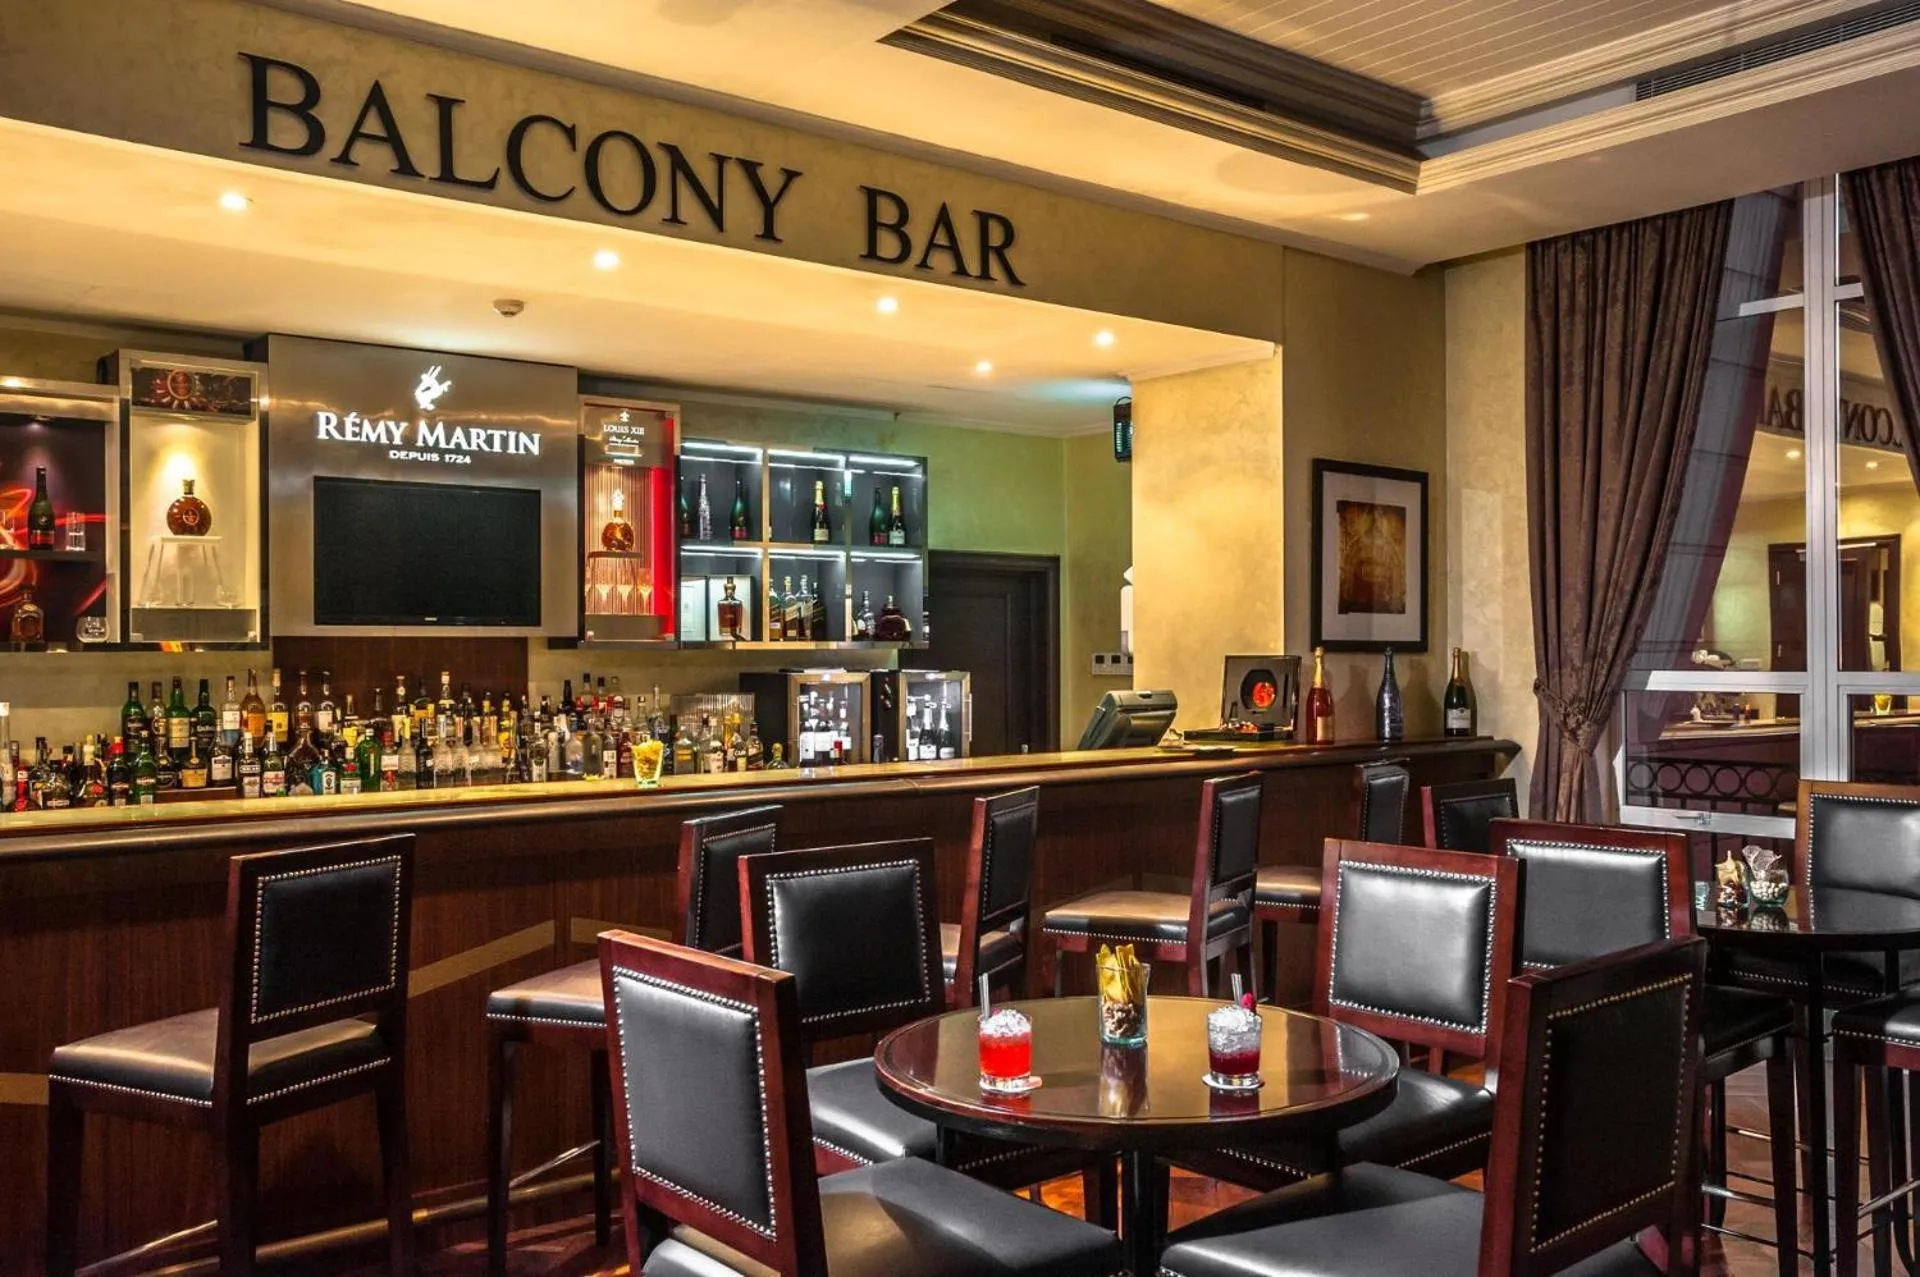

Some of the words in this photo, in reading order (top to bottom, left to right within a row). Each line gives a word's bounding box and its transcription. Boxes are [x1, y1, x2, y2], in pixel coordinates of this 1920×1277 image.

[237, 51, 803, 243] BALCONY
[858, 184, 1027, 287] BAR
[316, 411, 409, 446] RÉMY
[415, 419, 541, 456] MARTIN
[603, 424, 630, 434] LOUIS
[389, 450, 440, 463] DEPUIS
[444, 453, 472, 465] 1724
